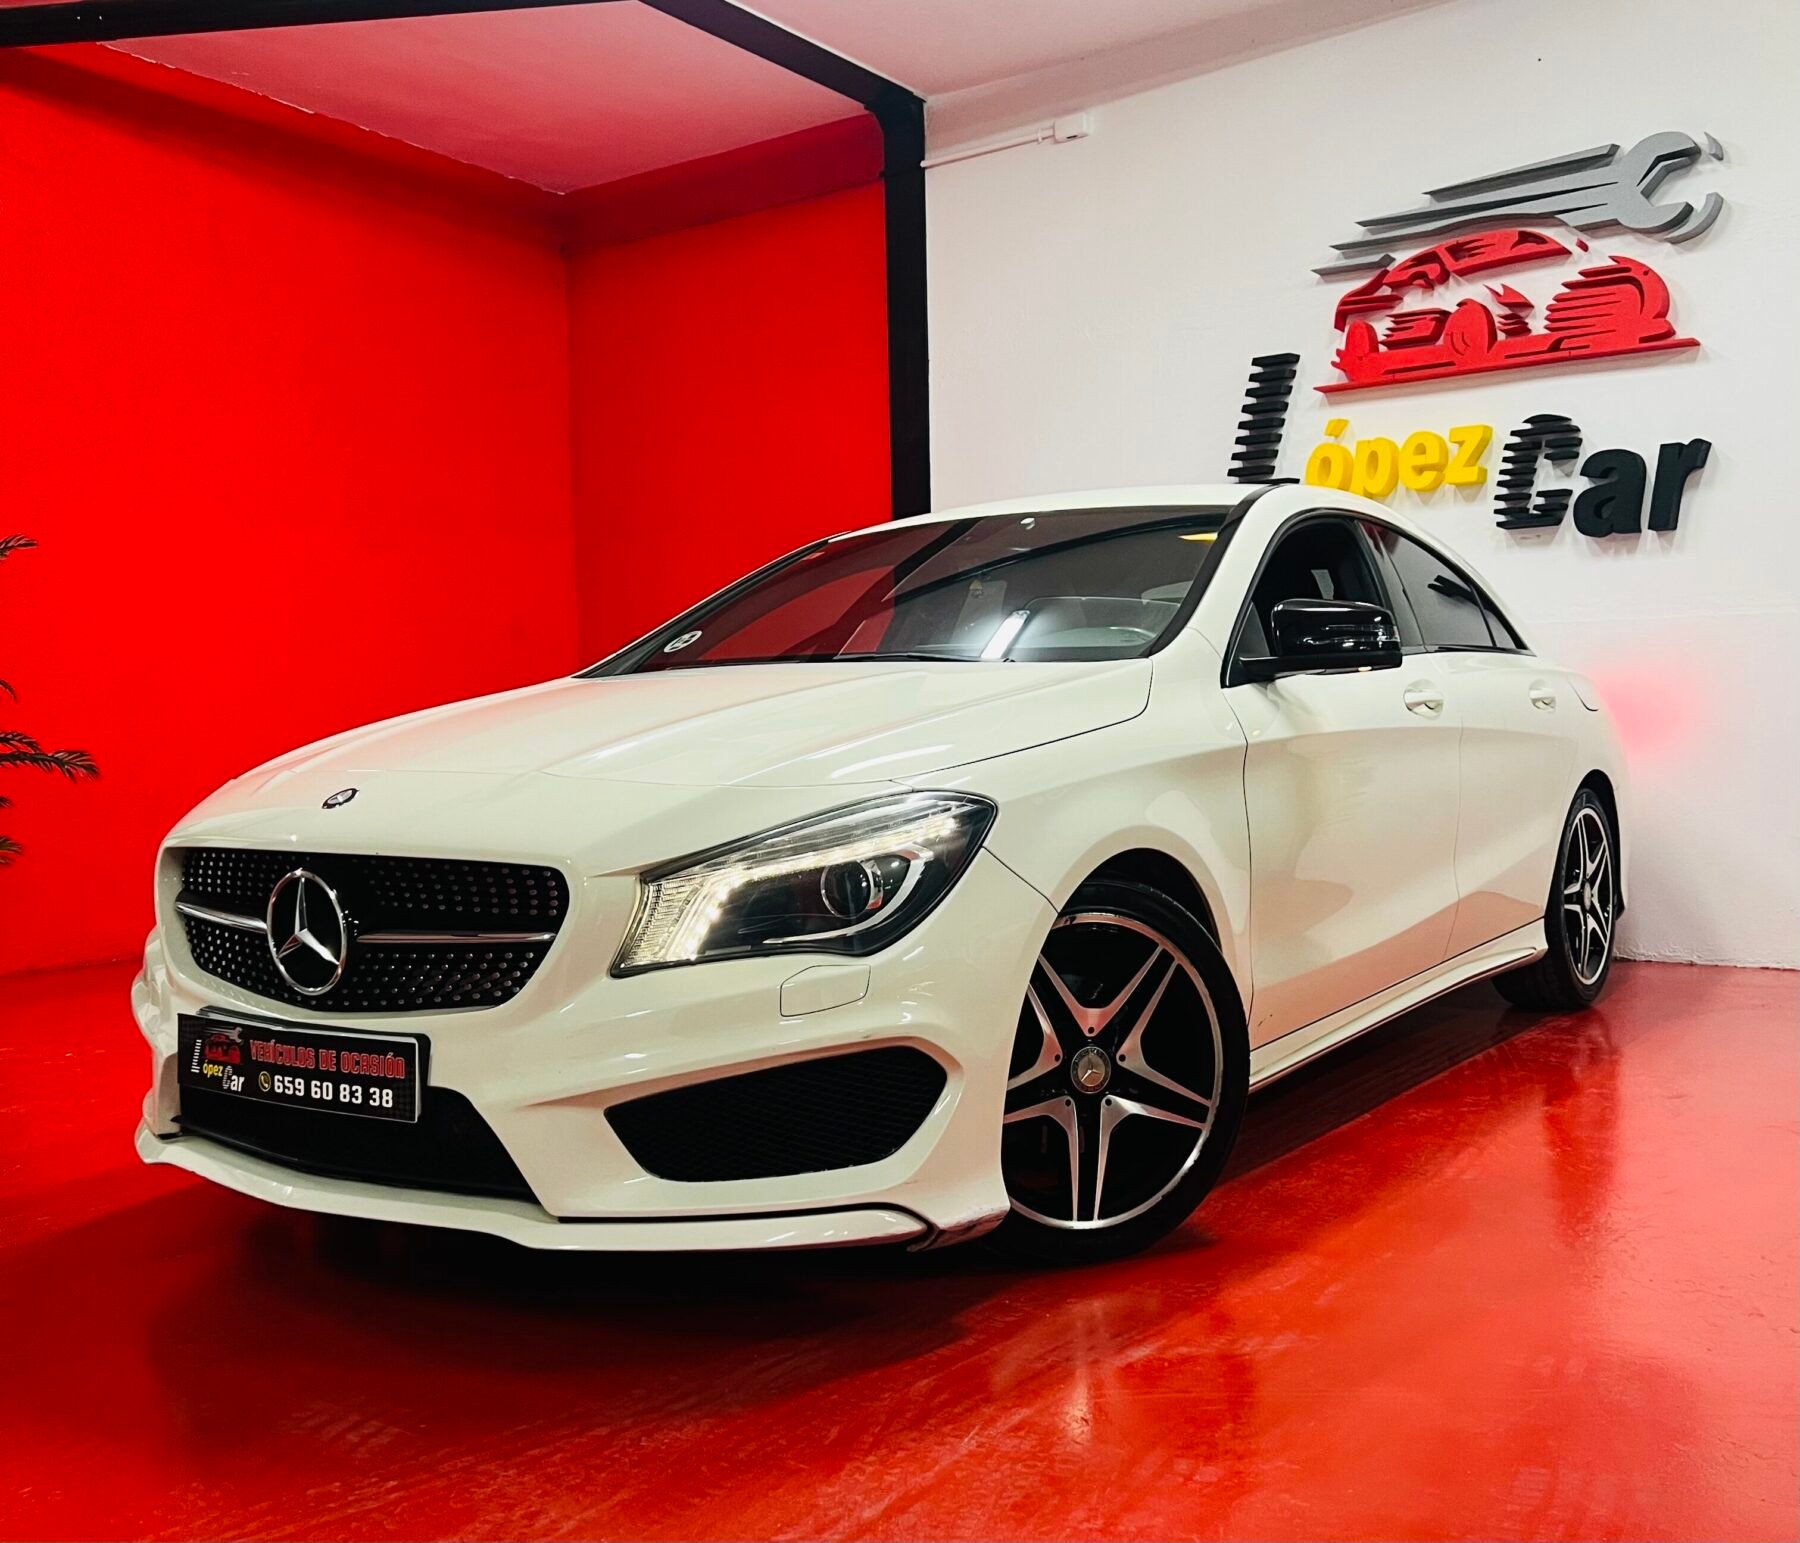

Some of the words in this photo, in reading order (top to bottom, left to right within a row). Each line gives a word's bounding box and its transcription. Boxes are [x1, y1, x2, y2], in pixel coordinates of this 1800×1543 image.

[1494, 413, 1712, 538] Car
[249, 1039, 315, 1069] VEHÍCULOS
[319, 1049, 337, 1072] DE
[222, 1065, 245, 1092] Car
[273, 1074, 305, 1097] 659
[310, 1080, 333, 1100] 60
[339, 1083, 363, 1104] 83
[369, 1087, 393, 1108] 38
